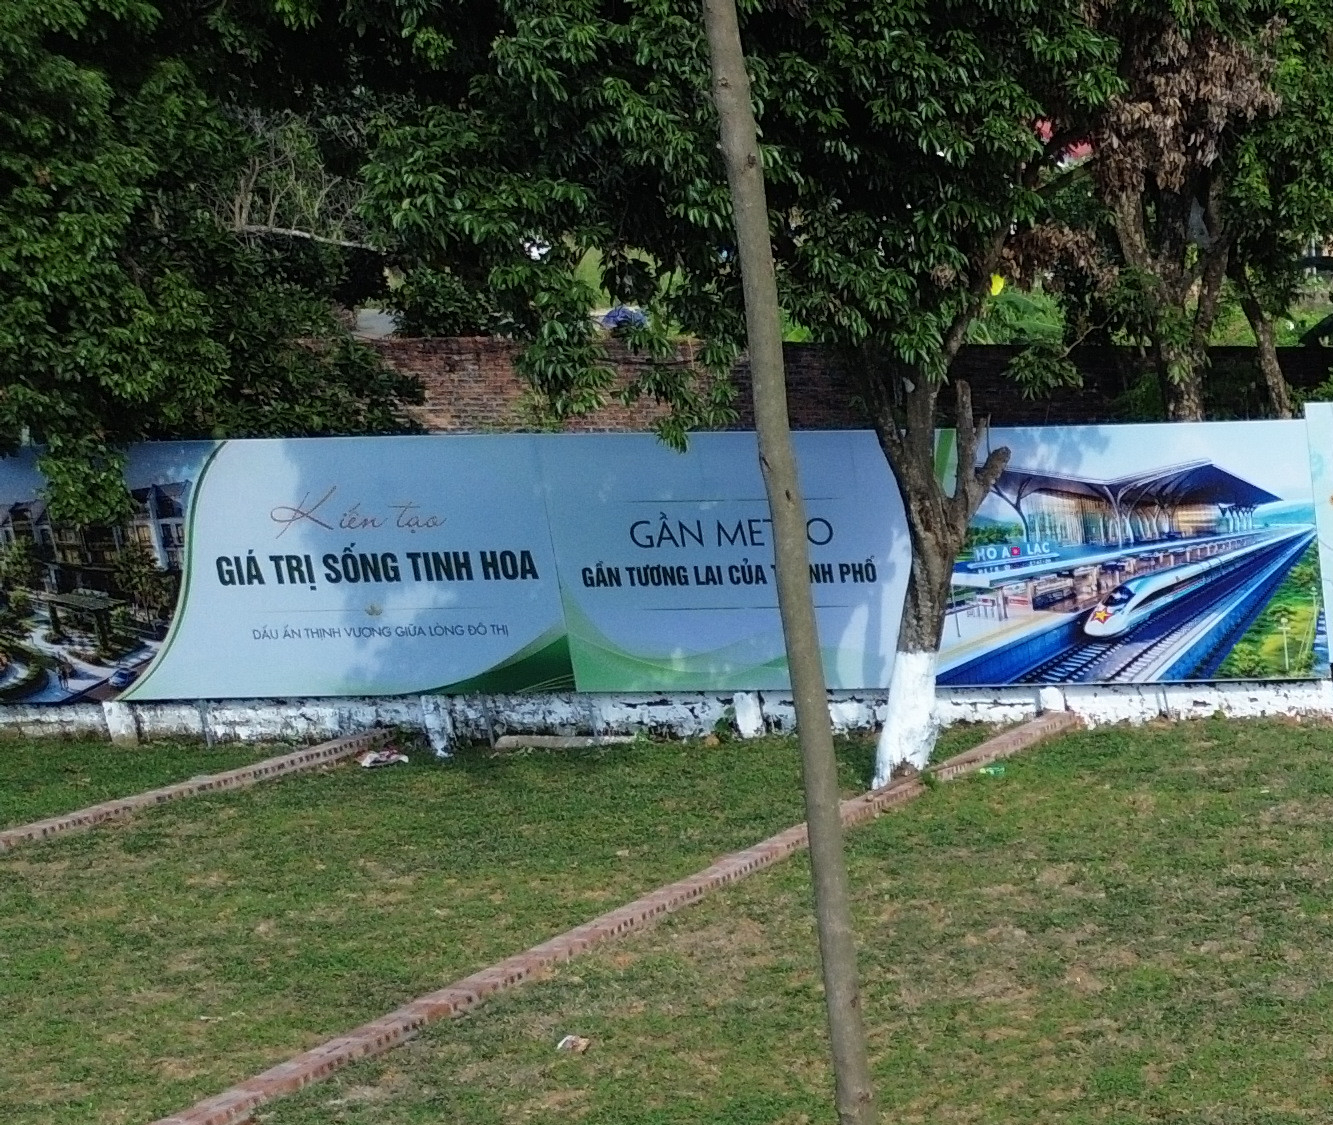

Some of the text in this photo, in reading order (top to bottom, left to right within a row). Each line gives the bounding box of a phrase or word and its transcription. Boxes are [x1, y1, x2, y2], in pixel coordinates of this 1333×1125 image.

[270, 486, 448, 539] Kiến tạo
[630, 511, 834, 549] GẦN MEO
[216, 542, 539, 591] GIÁ TRỊ SỐNG TINH HOA
[582, 561, 622, 587] GẦN
[625, 564, 689, 587] TƯƠNG
[693, 565, 724, 586] LAI
[728, 558, 768, 585] CỦA
[839, 555, 877, 583] PHỐ
[253, 625, 279, 640] DẤU
[283, 624, 301, 640] ẤN
[304, 627, 341, 641] THỊNH
[395, 623, 426, 637] GIỮA
[429, 622, 465, 636] LÒNG
[468, 622, 487, 636] ĐÔ
[490, 624, 509, 637] THỊ
